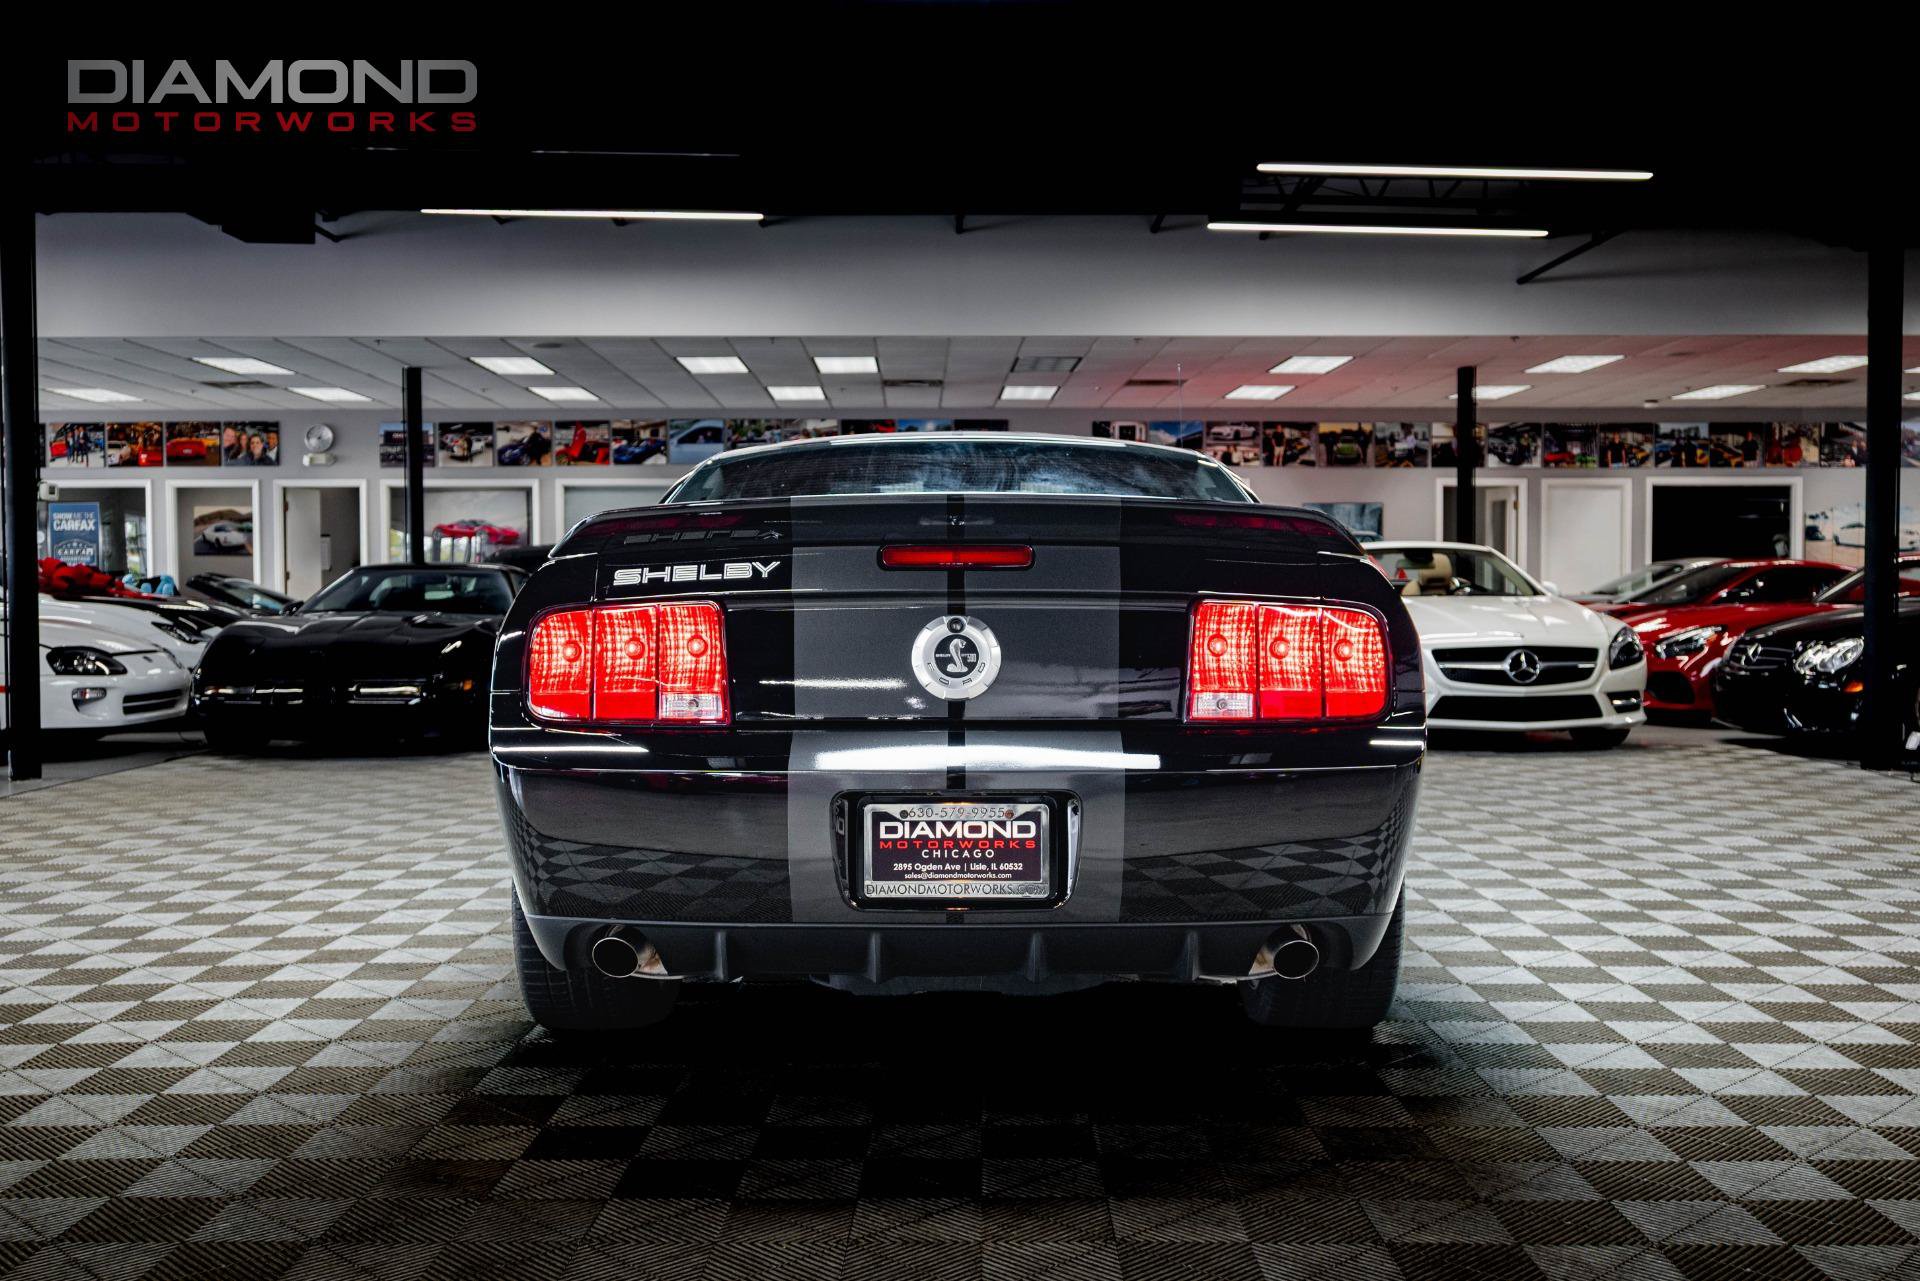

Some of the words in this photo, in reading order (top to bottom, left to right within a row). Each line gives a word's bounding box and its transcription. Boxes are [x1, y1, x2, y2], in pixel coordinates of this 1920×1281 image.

[53, 519, 96, 531] CARFAX
[613, 561, 781, 586] SHELBY
[908, 807, 1005, 818] 630-579-9955
[879, 821, 1036, 839] DIAMOND
[880, 840, 1036, 849] MOTORWORKS
[921, 849, 995, 858] CHICAGO
[893, 863, 913, 871] 2895
[914, 863, 943, 873] Ogden
[944, 863, 961, 871] Ave
[970, 863, 989, 872] Lisle,
[991, 863, 998, 871] IL
[999, 863, 1024, 871] 60532
[904, 872, 1012, 880] sales@diamondmotorworks.com
[866, 883, 1048, 896] DIAMONDMOTORWORKS.COM
